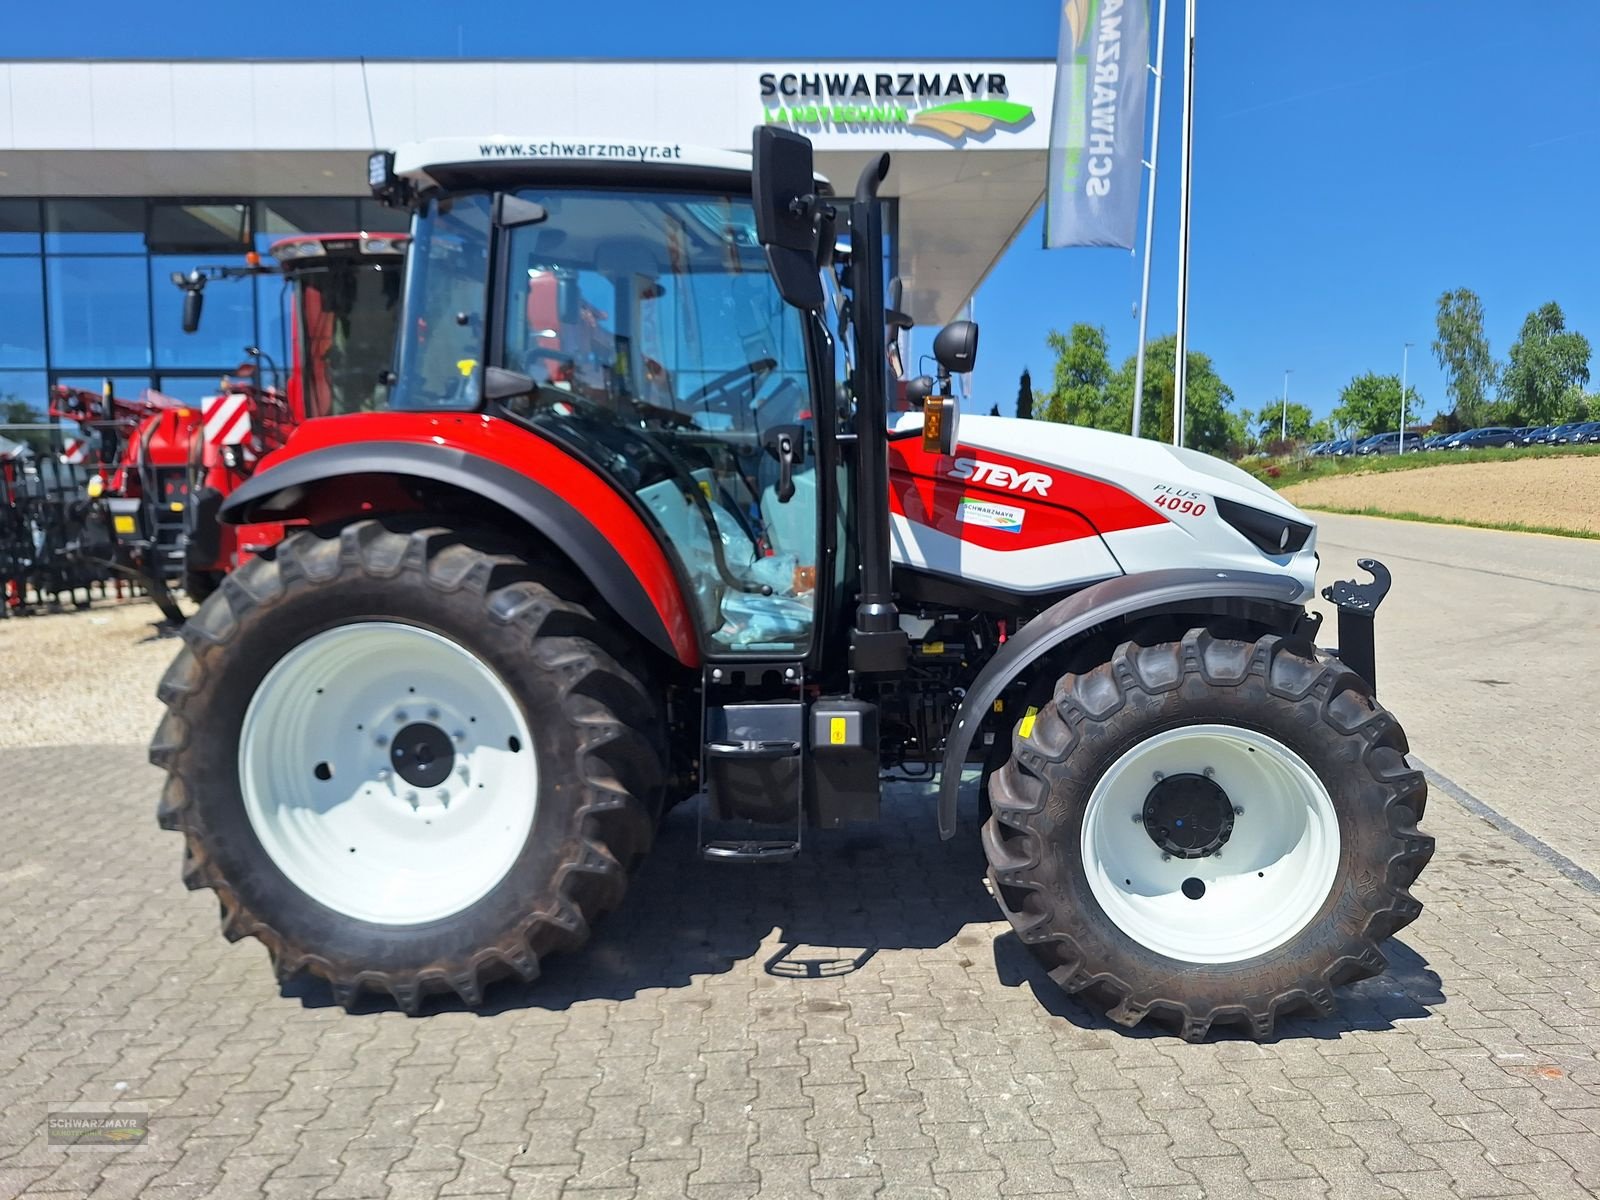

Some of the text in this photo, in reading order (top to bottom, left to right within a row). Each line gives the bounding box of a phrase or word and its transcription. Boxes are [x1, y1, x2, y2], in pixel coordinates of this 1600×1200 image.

[759, 73, 1007, 97] SCHWARZMAYR
[764, 105, 908, 122] LANDTECHNIK
[479, 142, 681, 163] www.schwarzmayr.at
[947, 457, 1053, 497] STEYR
[1153, 483, 1201, 500] PLUS
[964, 503, 1014, 519] SCHWARZMAYR
[1154, 493, 1206, 517] 4090
